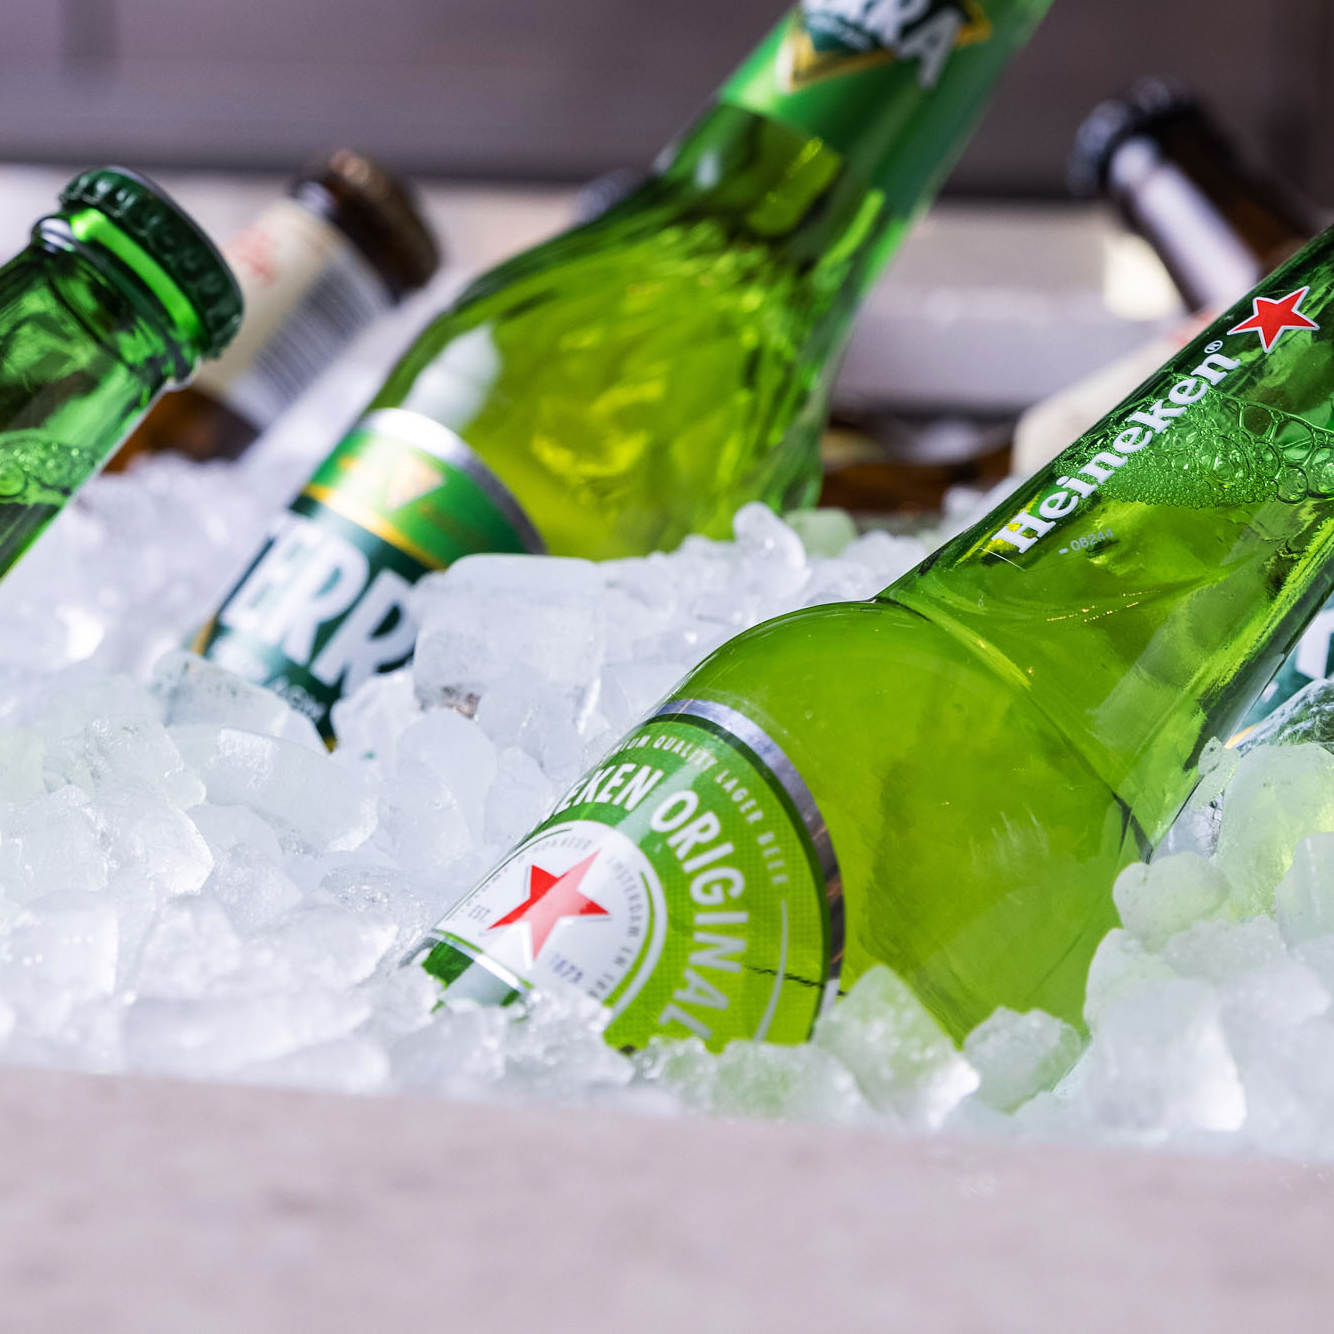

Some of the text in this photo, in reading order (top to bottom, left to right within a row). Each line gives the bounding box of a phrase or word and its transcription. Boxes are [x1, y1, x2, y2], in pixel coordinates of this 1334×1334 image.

[649, 788, 749, 1040] ORIGINAL
[715, 769, 764, 824] LAGER
[756, 831, 789, 885] BEER
